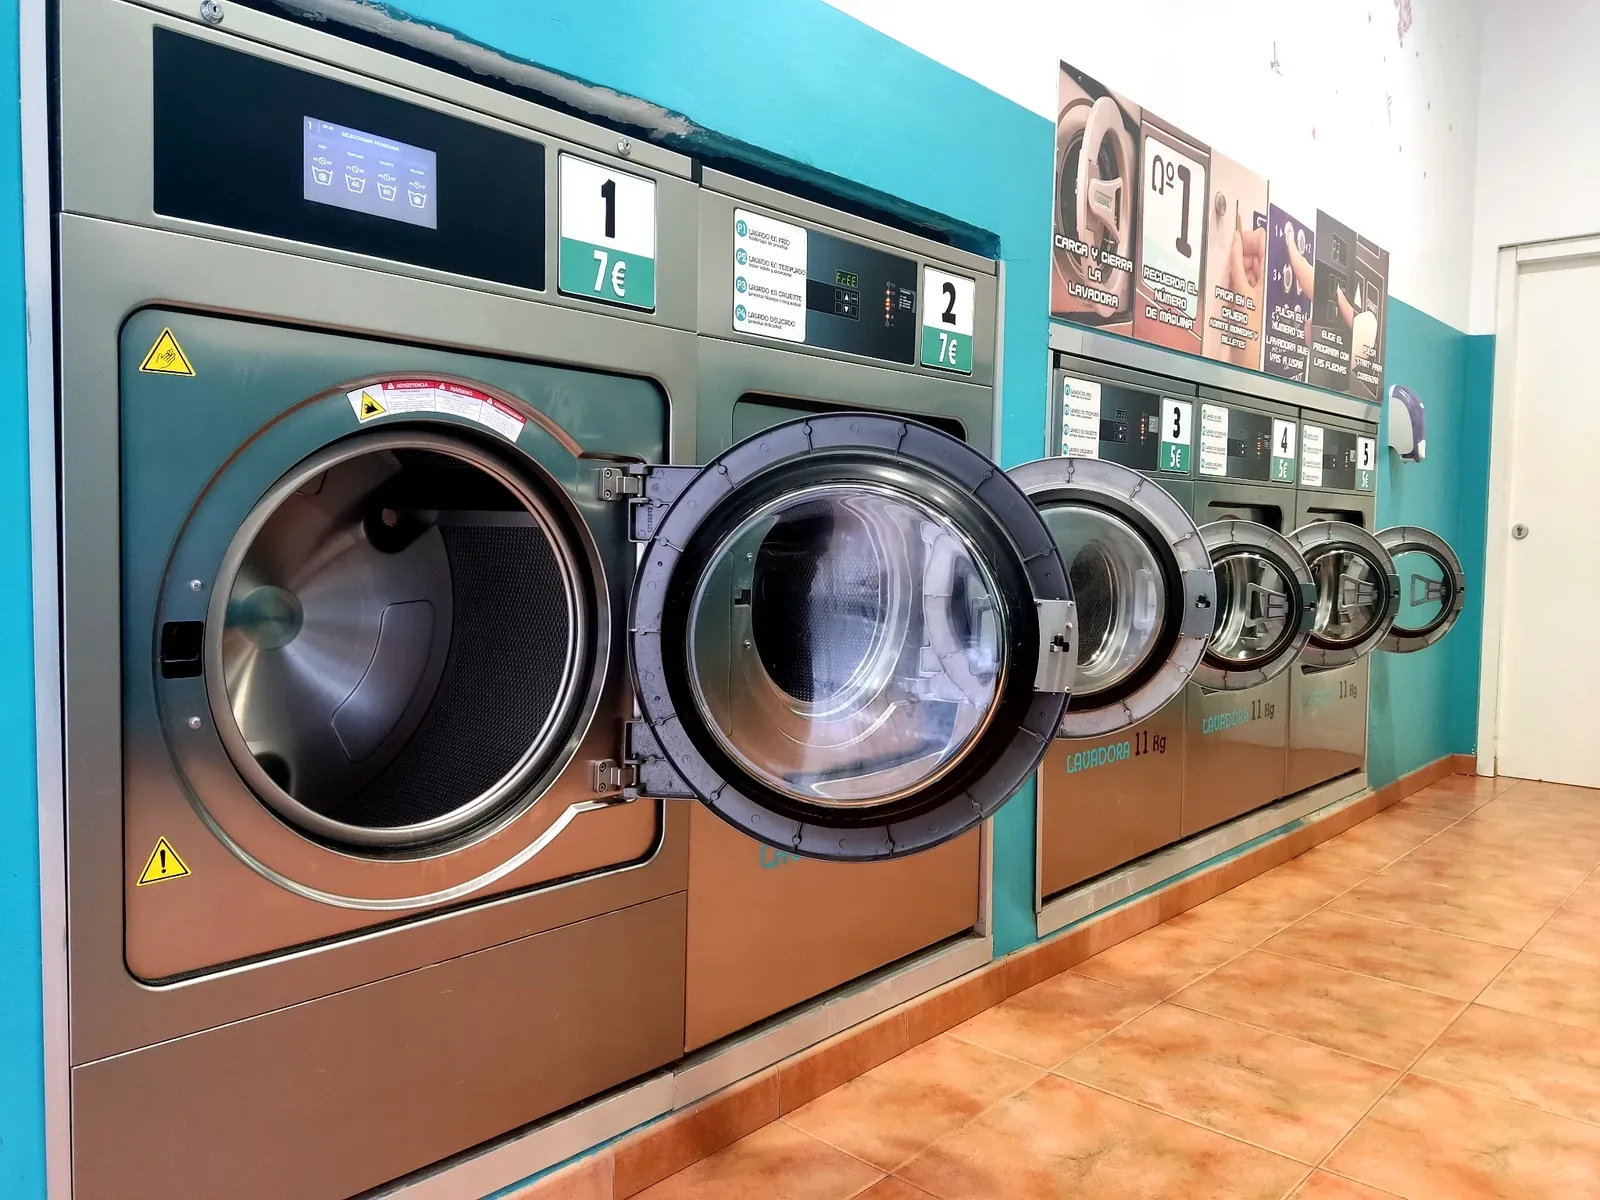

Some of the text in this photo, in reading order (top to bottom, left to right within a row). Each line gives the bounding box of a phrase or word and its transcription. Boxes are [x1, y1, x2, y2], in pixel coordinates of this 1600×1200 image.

[307, 121, 312, 130] 1
[341, 131, 400, 151] SELECCIONAR PROGRAMA
[601, 178, 616, 239] 1
[737, 222, 746, 234] P1
[737, 251, 746, 263] P2
[1054, 234, 1133, 272] CARGA Y CIERRA
[593, 249, 626, 298] 7€
[1088, 267, 1102, 282] LA
[1143, 266, 1198, 296] RECUERDA EL
[1273, 268, 1277, 281] 3
[737, 280, 746, 290] P3
[1068, 282, 1118, 308] LAVADORA
[942, 281, 956, 326] 2
[1154, 288, 1188, 310] NÚMERO
[1215, 286, 1256, 311] PAGA EN EL
[736, 308, 746, 319] P4
[1145, 306, 1193, 330] DE MÁQUINA
[1221, 306, 1248, 325] CAJERO
[1275, 305, 1294, 320] PULSA
[1295, 313, 1303, 323] EL
[1209, 318, 1229, 332] ADMITE
[1229, 324, 1253, 339] MONEDAS
[1272, 320, 1305, 339] NÚMERO DE
[1321, 330, 1344, 345] ELIGE EL
[938, 332, 957, 366] 7€
[1221, 334, 1246, 350] BILLETES
[1266, 334, 1309, 356] LAVADORA QUE
[1313, 342, 1350, 361] PROGRAMA CON
[1270, 352, 1303, 370] VAS A USAR
[1314, 358, 1347, 375] LAS FLECHAS
[1357, 371, 1379, 385] COMENZAR
[1172, 406, 1181, 438] 3
[1280, 426, 1288, 453] 4
[1170, 445, 1181, 468] 5€
[1363, 442, 1369, 466] 5
[1278, 459, 1288, 479] 5€
[1340, 680, 1348, 699] 11
[1202, 699, 1276, 735] LAVADORA 11 Kg
[1066, 730, 1167, 774] LAVADORA 11 Kg
